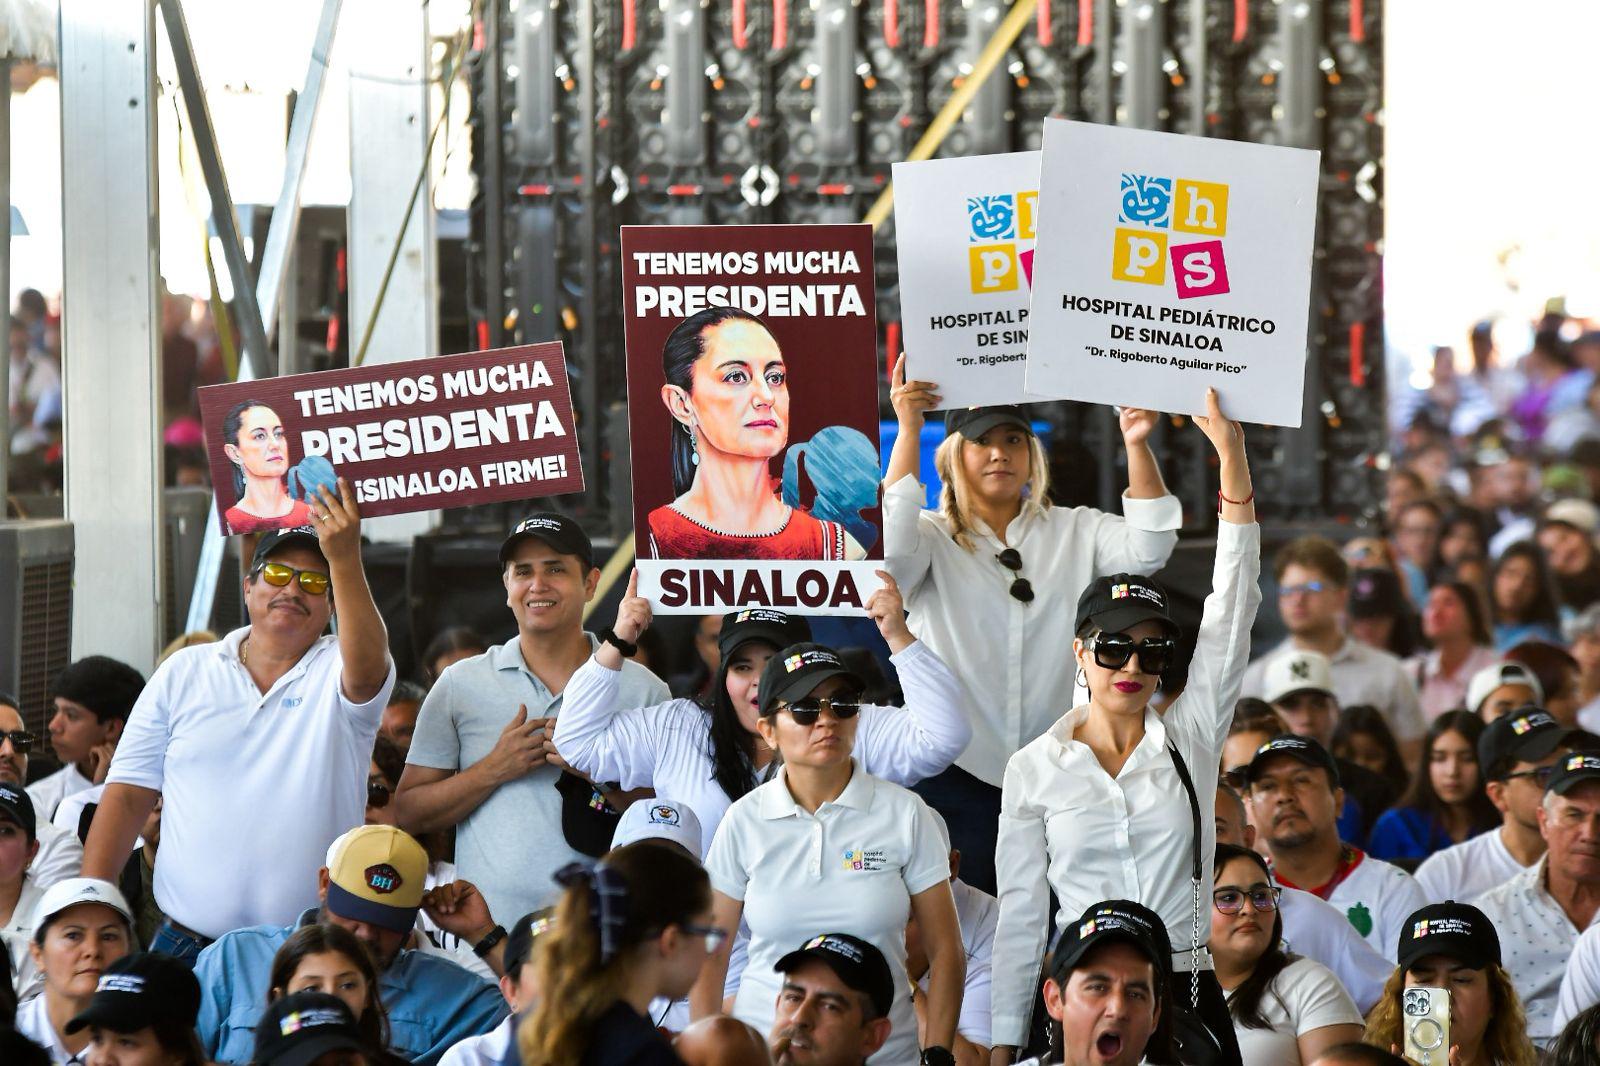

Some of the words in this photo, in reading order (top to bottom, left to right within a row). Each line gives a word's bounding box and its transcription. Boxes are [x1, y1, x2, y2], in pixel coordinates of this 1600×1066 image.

[1184, 186, 1217, 229] h
[633, 251, 759, 275] TENEMOS
[764, 250, 861, 274] MUCHA
[980, 250, 1011, 289] p
[1124, 235, 1159, 277] p
[1182, 251, 1216, 289] s
[635, 284, 867, 317] PRESIDENTA
[1062, 294, 1156, 321] HOSPITAL
[1159, 307, 1276, 335] PEDIÁTRICO
[930, 310, 1015, 331] HOSPITAL
[976, 332, 999, 347] DE
[1110, 324, 1135, 341] DE
[1139, 328, 1224, 352] SINALOA
[1109, 349, 1168, 365] Rigoberto
[1170, 357, 1213, 371] Aguilar
[294, 375, 438, 418] TENEMOS
[441, 360, 554, 398] MUCHA
[301, 400, 567, 465] PRESIDENTA
[355, 466, 478, 504] ¡SINALOA
[481, 454, 568, 488] FIRME!
[659, 569, 864, 608] SINALOA
[372, 875, 392, 889] BH
